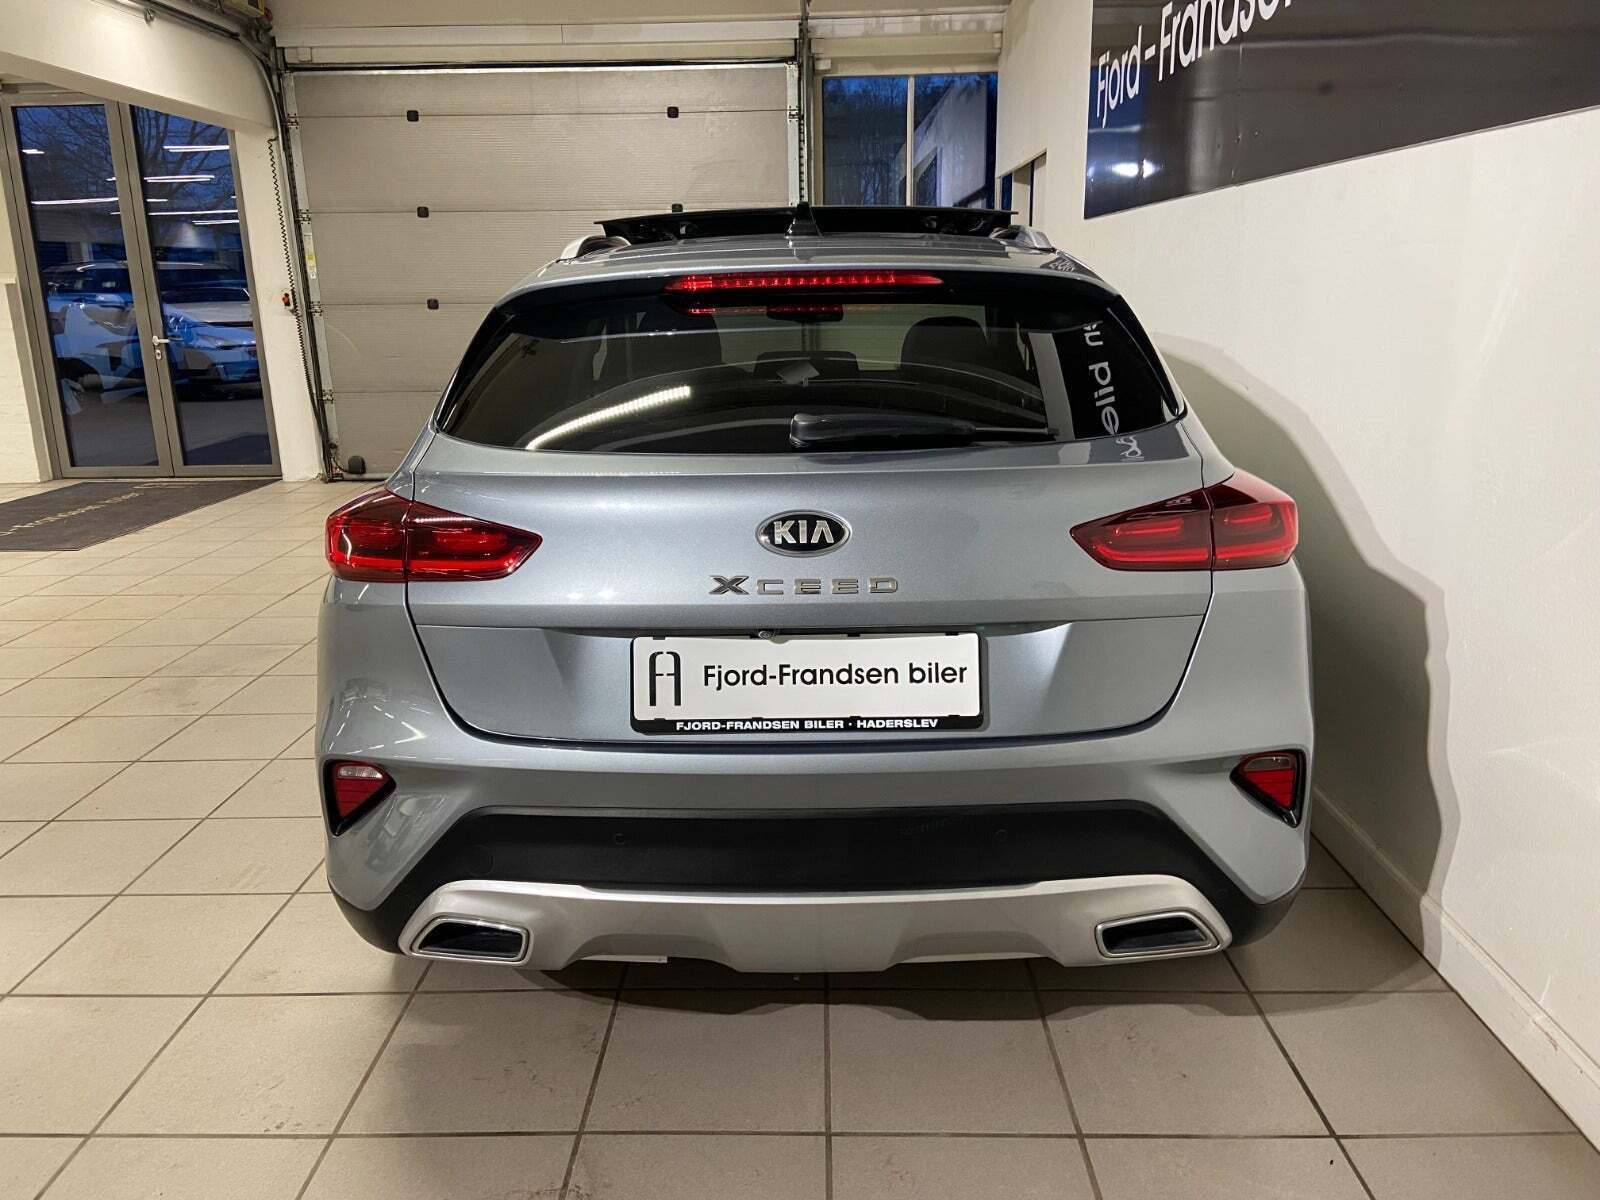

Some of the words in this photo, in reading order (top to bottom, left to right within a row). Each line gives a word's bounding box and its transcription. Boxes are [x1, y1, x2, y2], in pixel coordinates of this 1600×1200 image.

[774, 520, 834, 544] KIA
[709, 575, 898, 595] XCEED
[703, 663, 898, 691] Fjord-Frandsen
[909, 662, 967, 684] biler
[676, 721, 799, 731] FJORD-FRANDSEN
[805, 720, 843, 730] BILER
[857, 719, 938, 729] HADERSLEV
